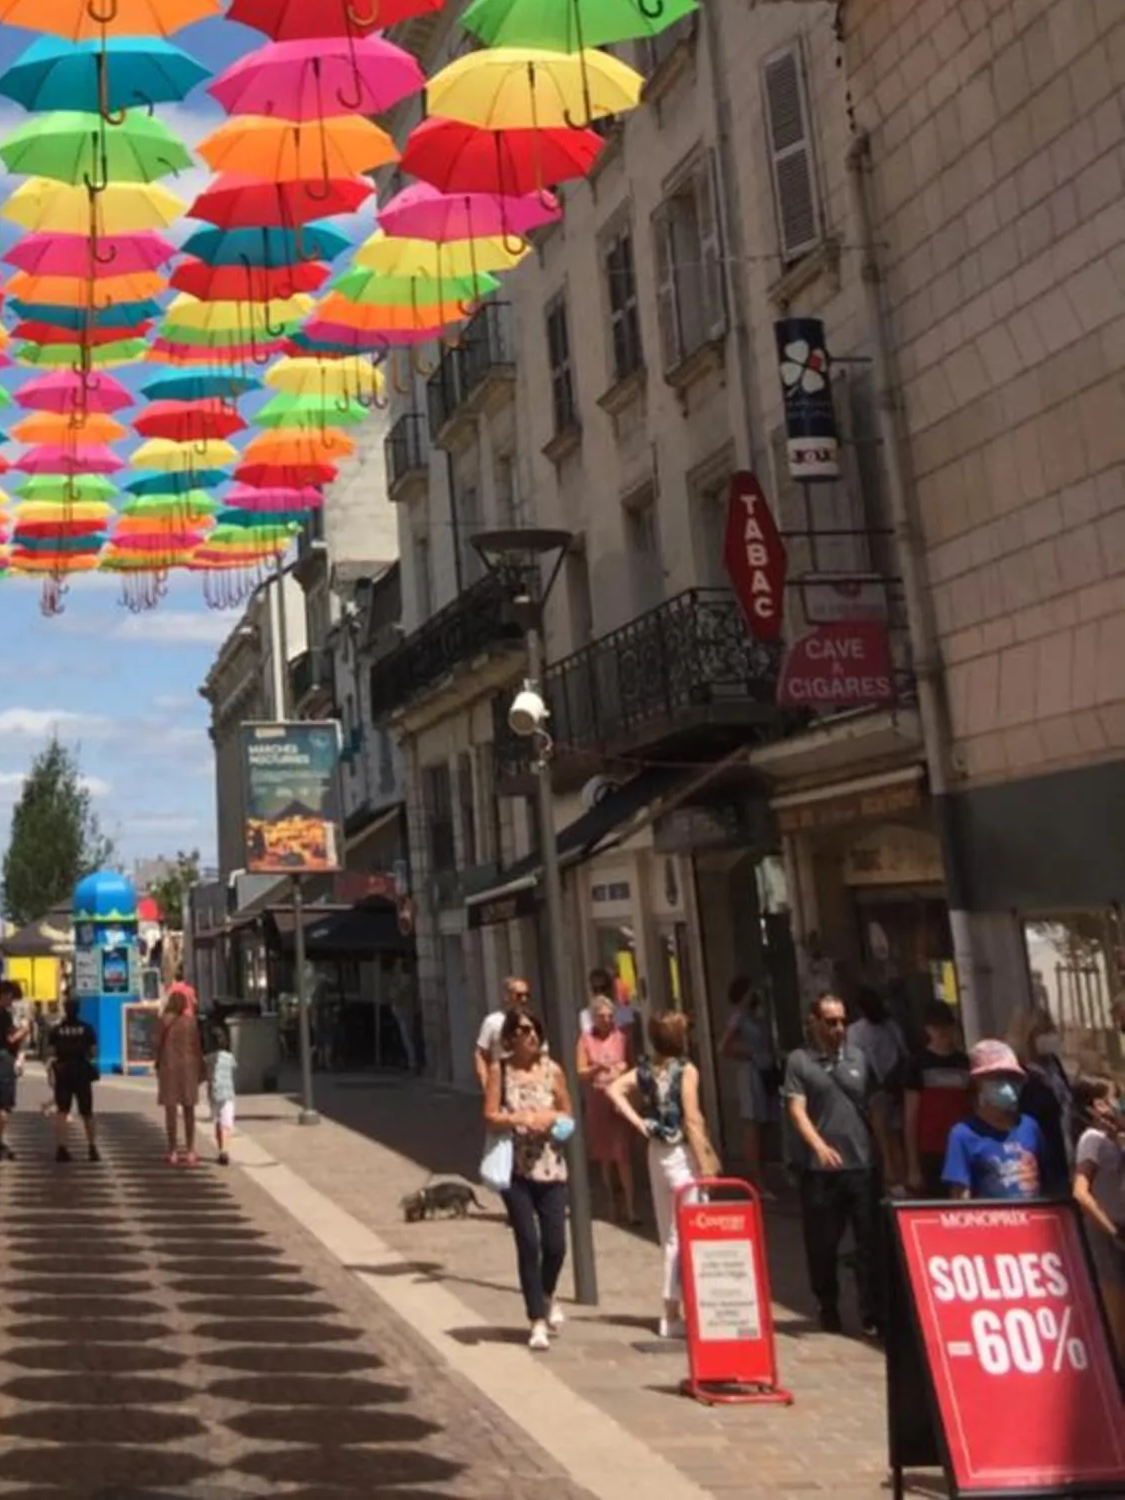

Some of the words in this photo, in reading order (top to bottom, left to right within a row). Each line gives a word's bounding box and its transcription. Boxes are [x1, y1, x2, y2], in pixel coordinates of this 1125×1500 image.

[739, 494, 775, 619] TABAC
[805, 637, 866, 660] CAVE
[788, 676, 891, 700] CIGARES
[939, 1209, 1030, 1229] MONOPRIX
[928, 1252, 1070, 1303] SOLDES
[947, 1306, 1088, 1375] -60%
